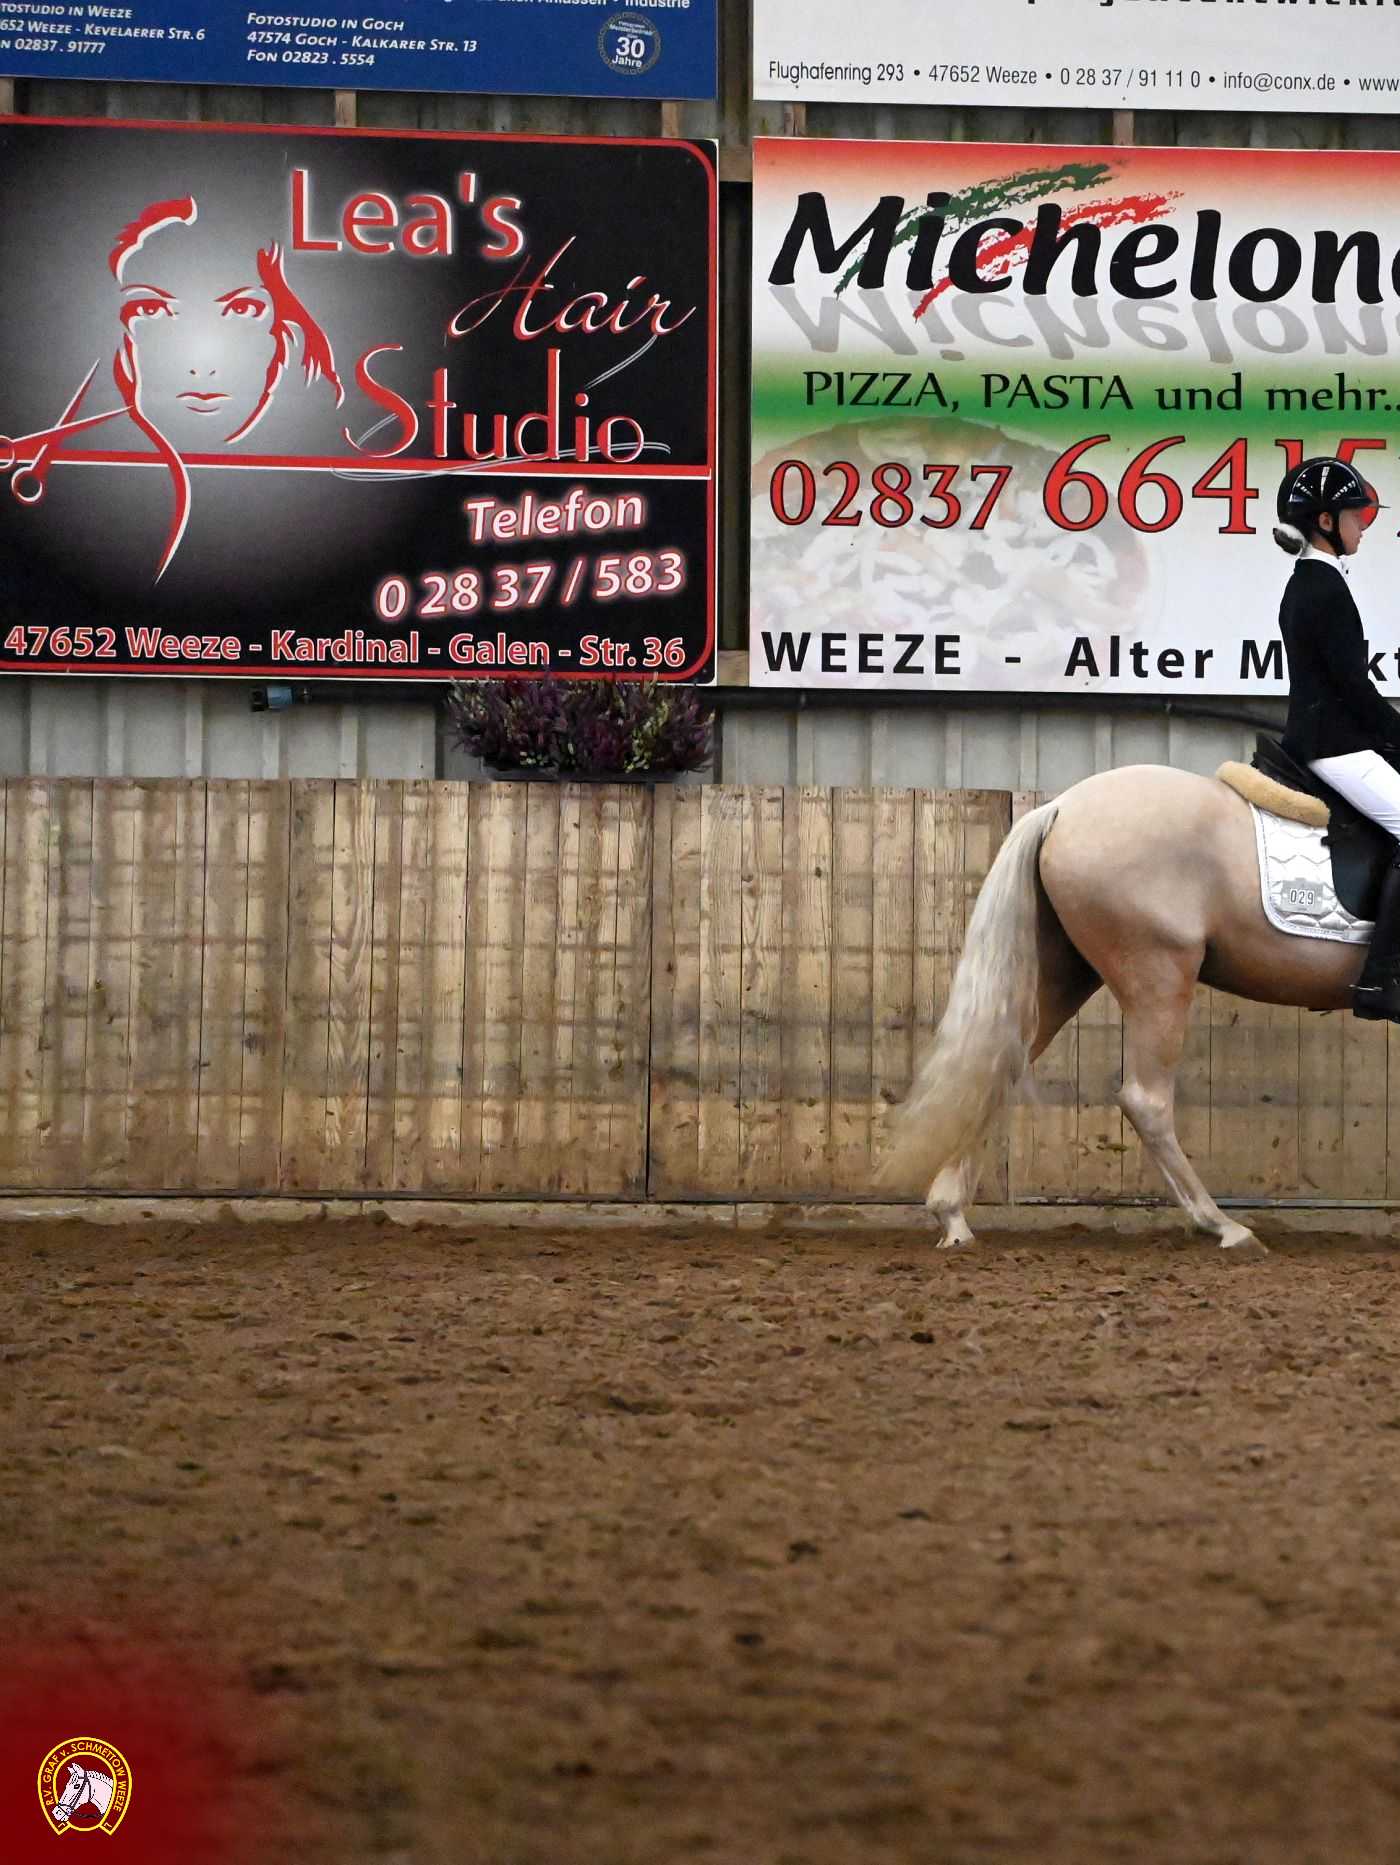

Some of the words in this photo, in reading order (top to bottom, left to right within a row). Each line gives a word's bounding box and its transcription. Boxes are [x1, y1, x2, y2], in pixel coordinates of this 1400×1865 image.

[28, 20, 73, 34] WEEZE
[84, 23, 165, 39] KEVELAERER
[69, 7, 84, 16] IN
[88, 5, 134, 19] WEEZE
[246, 12, 338, 28] FOTOSTUDIO
[341, 18, 358, 29] IN
[362, 17, 405, 31] GOCH
[14, 38, 58, 52] 02837
[67, 40, 106, 54] 91777
[246, 49, 277, 62] FON
[282, 50, 328, 64] 02823
[339, 52, 375, 66] 5554
[247, 31, 292, 44] 47574
[295, 33, 338, 46] GOCH
[351, 35, 426, 50] KALKARER
[430, 38, 459, 52] STR.
[463, 39, 478, 52] 13
[615, 36, 646, 58] 30
[611, 55, 643, 68] Jahre
[768, 60, 872, 85] Flughafenring
[876, 63, 905, 82] 293
[928, 65, 981, 83] 47652
[985, 66, 1038, 84] Weeze
[1223, 71, 1336, 92] info@conx.de
[289, 167, 525, 259] Lea's
[443, 234, 697, 342] Hair
[344, 344, 646, 464] Studio
[803, 371, 960, 412] PIZZA,
[981, 373, 1134, 411] PASTA
[1156, 373, 1244, 412] und
[769, 459, 1013, 531] 02837
[465, 490, 645, 544] Telefon
[376, 578, 408, 622] 0
[420, 570, 481, 616] 28
[493, 563, 553, 608] 37
[595, 551, 685, 599] 583
[3, 625, 118, 658] 47652
[125, 627, 241, 660] Weeze
[271, 629, 420, 664] Kardinal
[448, 632, 550, 666] Galen
[761, 631, 963, 675] WEEZE
[1064, 636, 1213, 680] Alter
